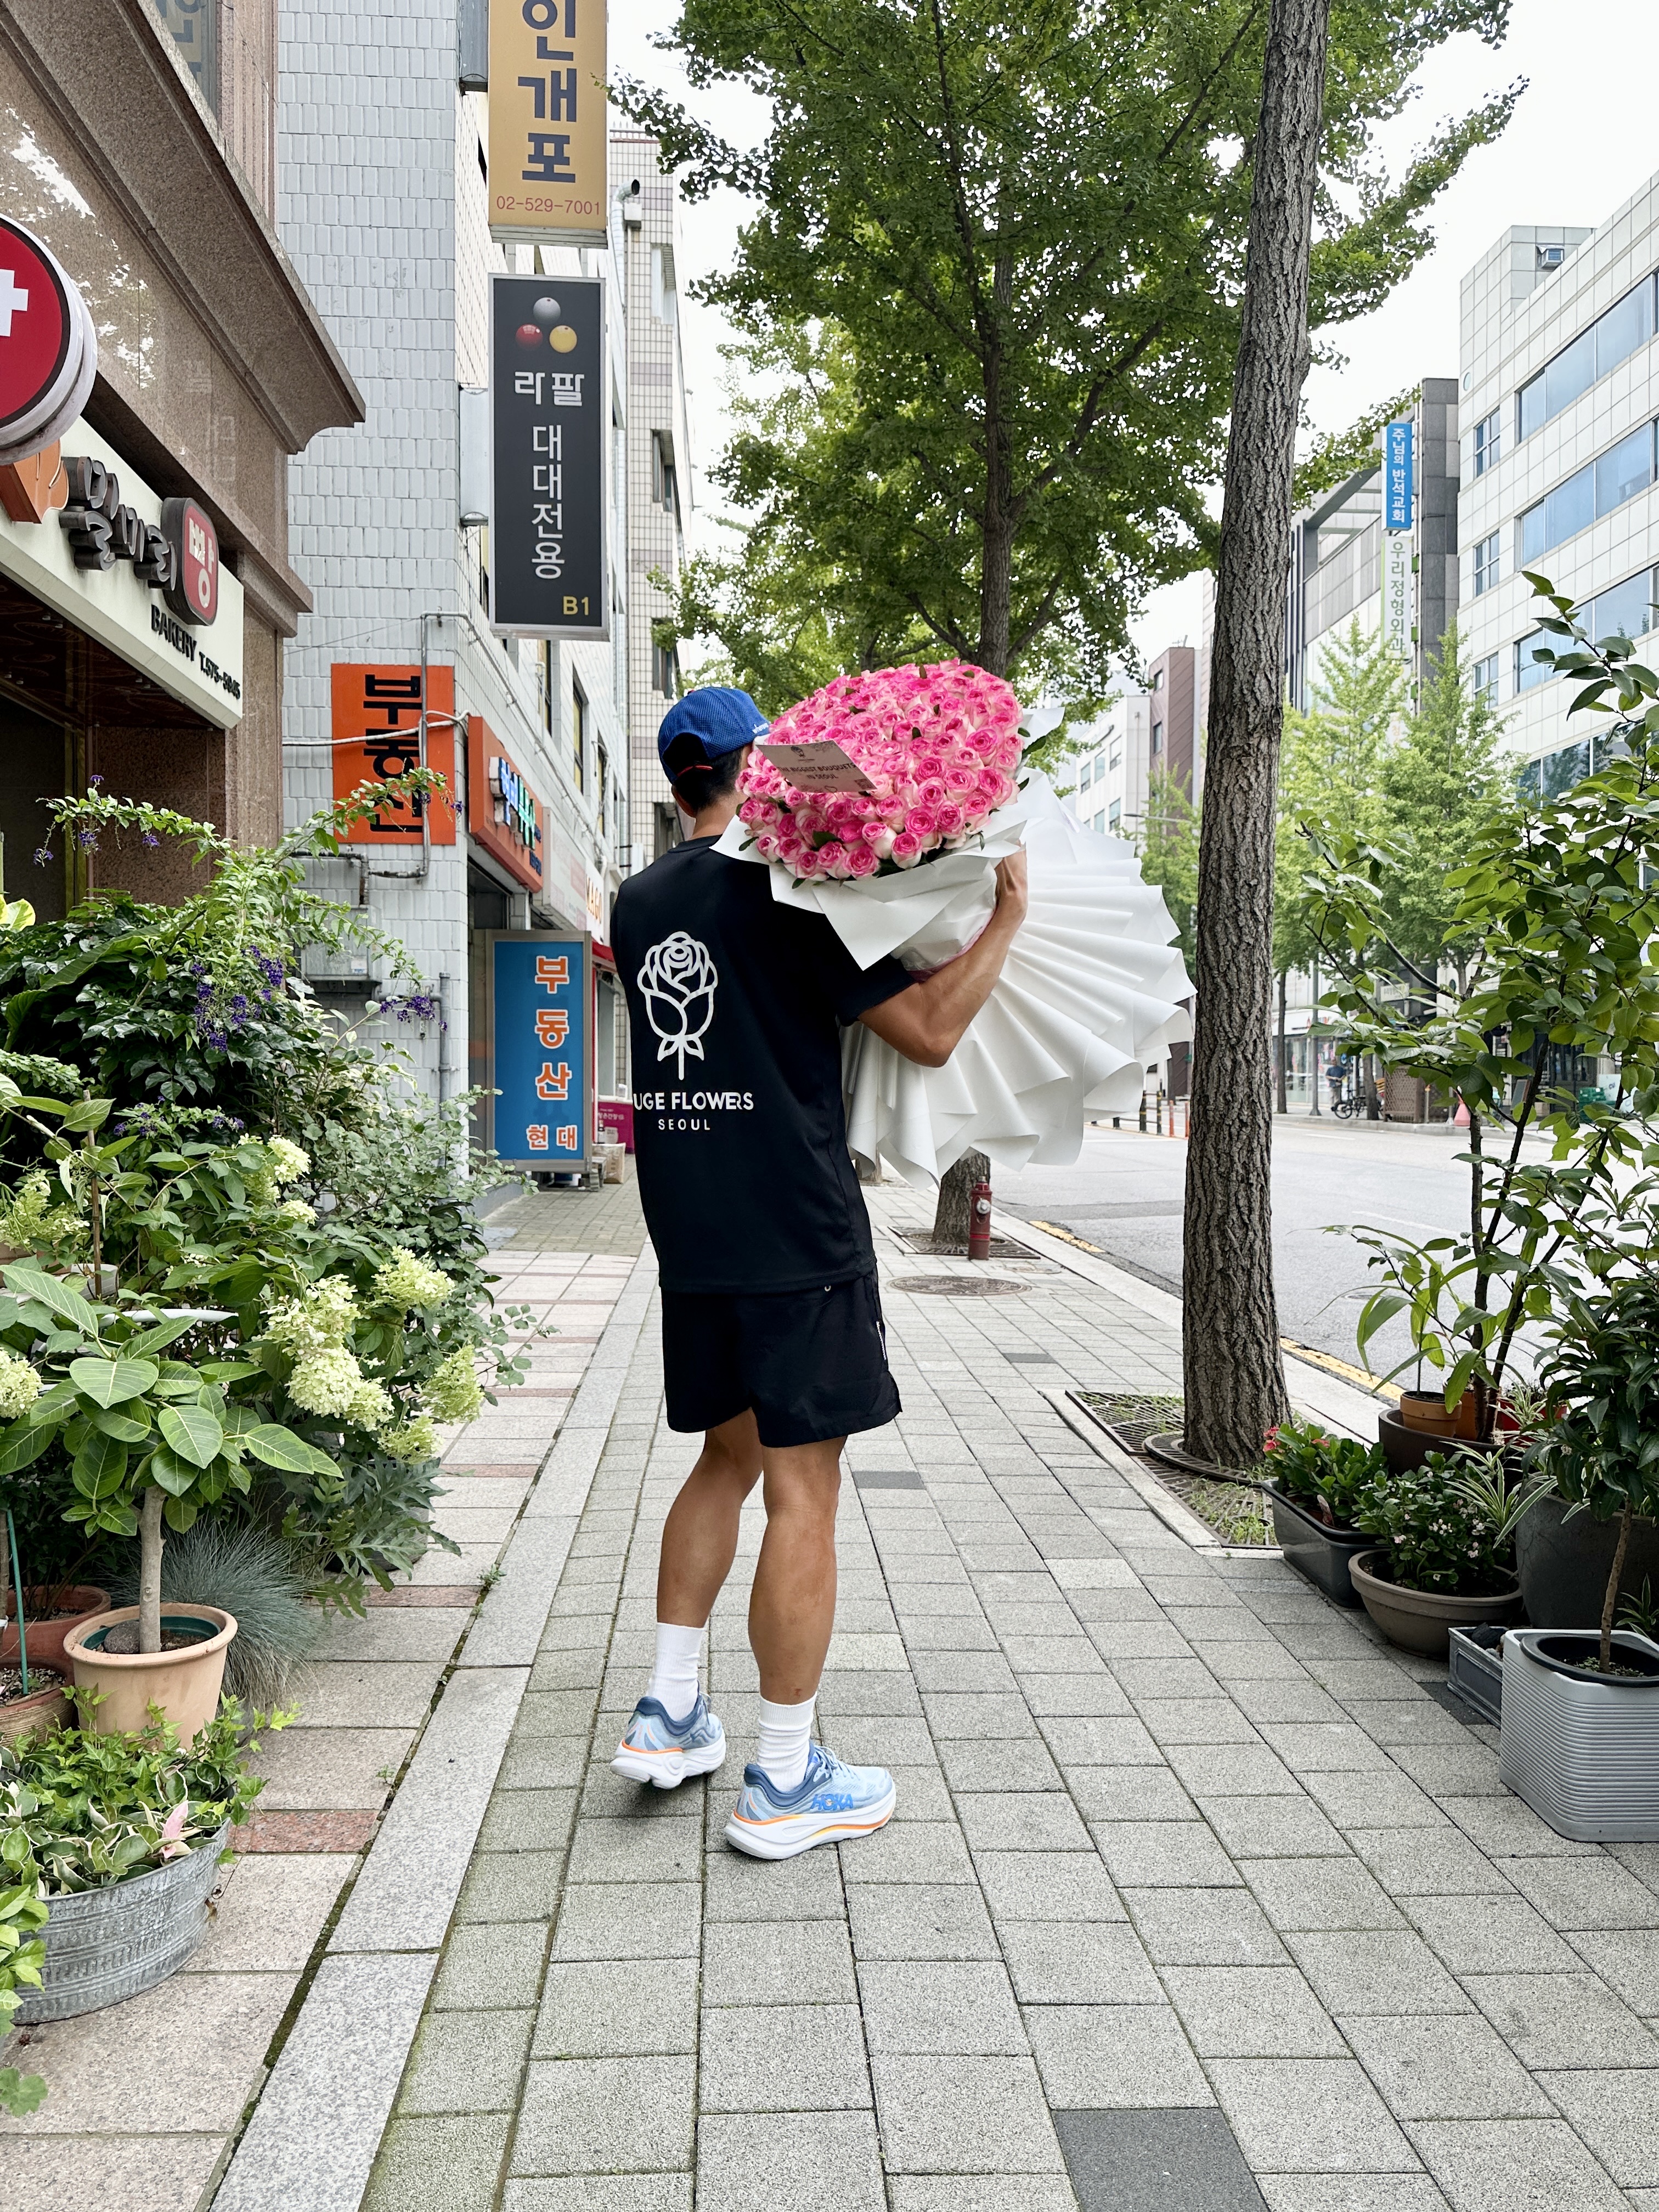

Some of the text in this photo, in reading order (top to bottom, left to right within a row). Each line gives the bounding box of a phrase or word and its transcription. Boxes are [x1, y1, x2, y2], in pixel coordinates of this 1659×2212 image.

[496, 196, 600, 215] 02-529-7001
[514, 371, 585, 407] 라팔
[1392, 428, 1406, 523] 주님의 반석교회
[531, 425, 565, 579] 대대전용
[189, 517, 215, 609] 빵
[562, 596, 589, 616] B1
[1390, 542, 1406, 654] 우리정형외과
[151, 604, 198, 662] BAKERY
[817, 763, 856, 771] BOUQUETS
[534, 955, 572, 1101] 부동산
[672, 1092, 754, 1110] FLOWERS
[527, 1125, 577, 1151] 현대
[658, 1119, 710, 1130] SEOUL
[810, 1793, 853, 1810] HOKA
